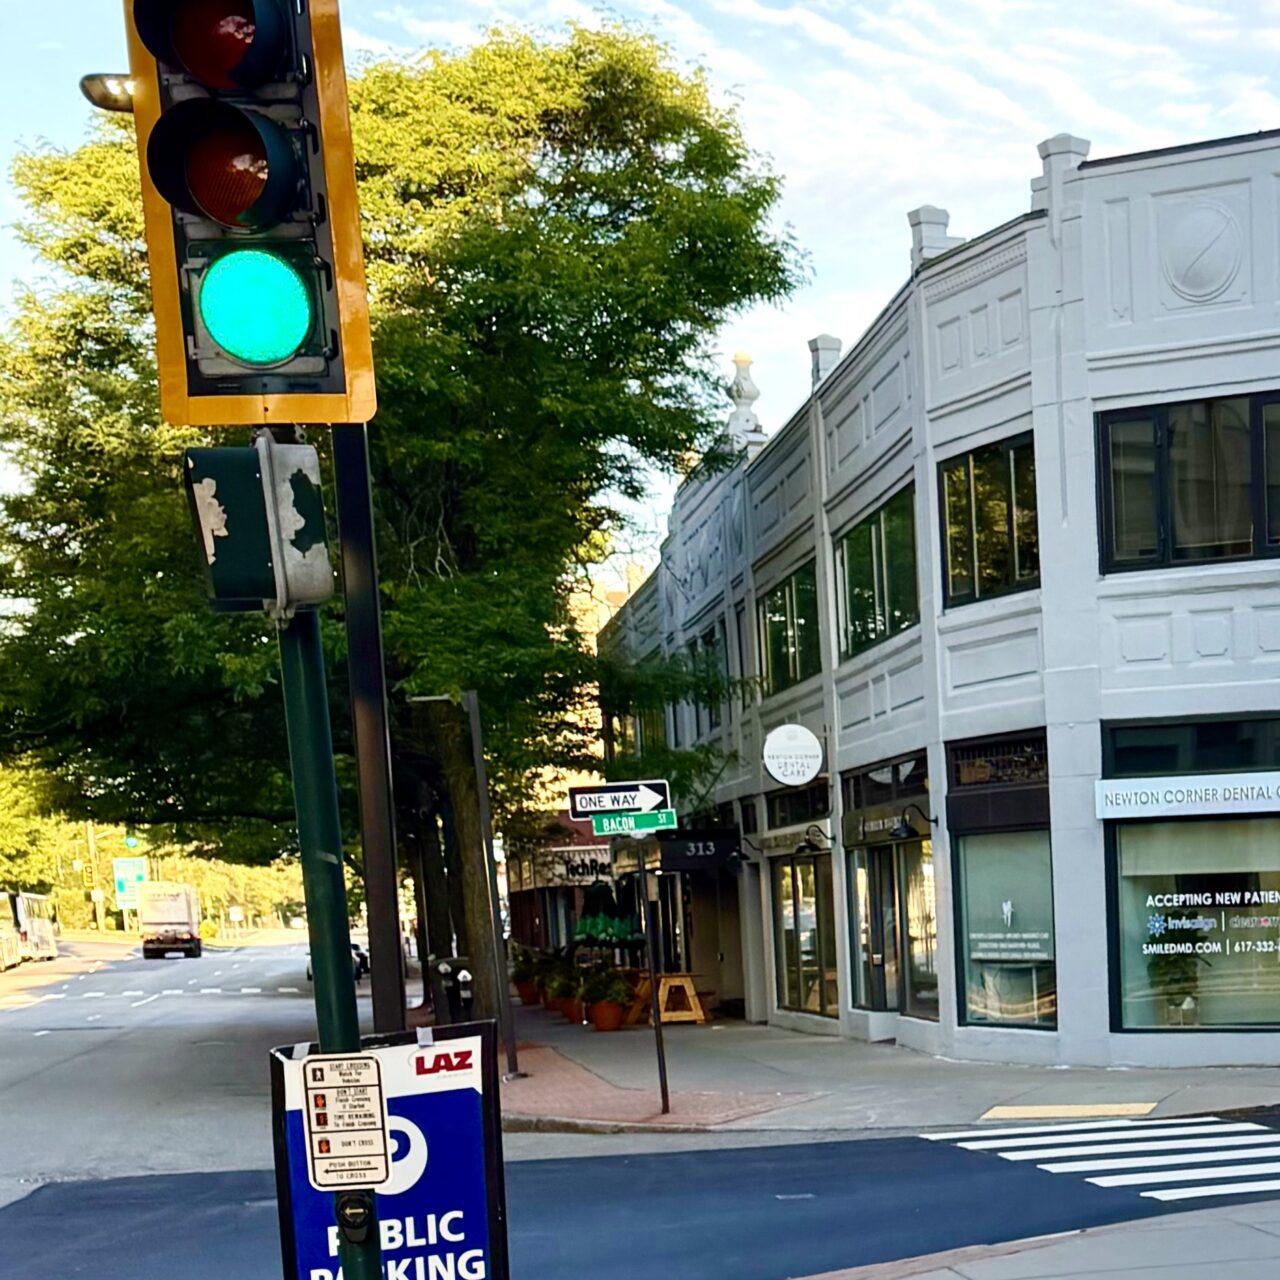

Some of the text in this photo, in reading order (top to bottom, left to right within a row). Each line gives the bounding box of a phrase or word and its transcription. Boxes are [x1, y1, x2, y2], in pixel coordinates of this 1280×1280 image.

[579, 794, 637, 809] ONE WAY
[1105, 790, 1160, 807] NEWTON
[1163, 788, 1218, 804] CORNER
[1223, 786, 1272, 801] DENTAL
[603, 813, 667, 832] BACON ST
[686, 841, 716, 856] 313
[1146, 892, 1212, 908] ACCEPTING
[1215, 891, 1241, 904] NEW
[1142, 941, 1222, 955] SMILEDMD.COM
[415, 1050, 473, 1076] LAZ
[327, 1210, 465, 1257] PBLIC
[310, 1249, 486, 1280] KING
